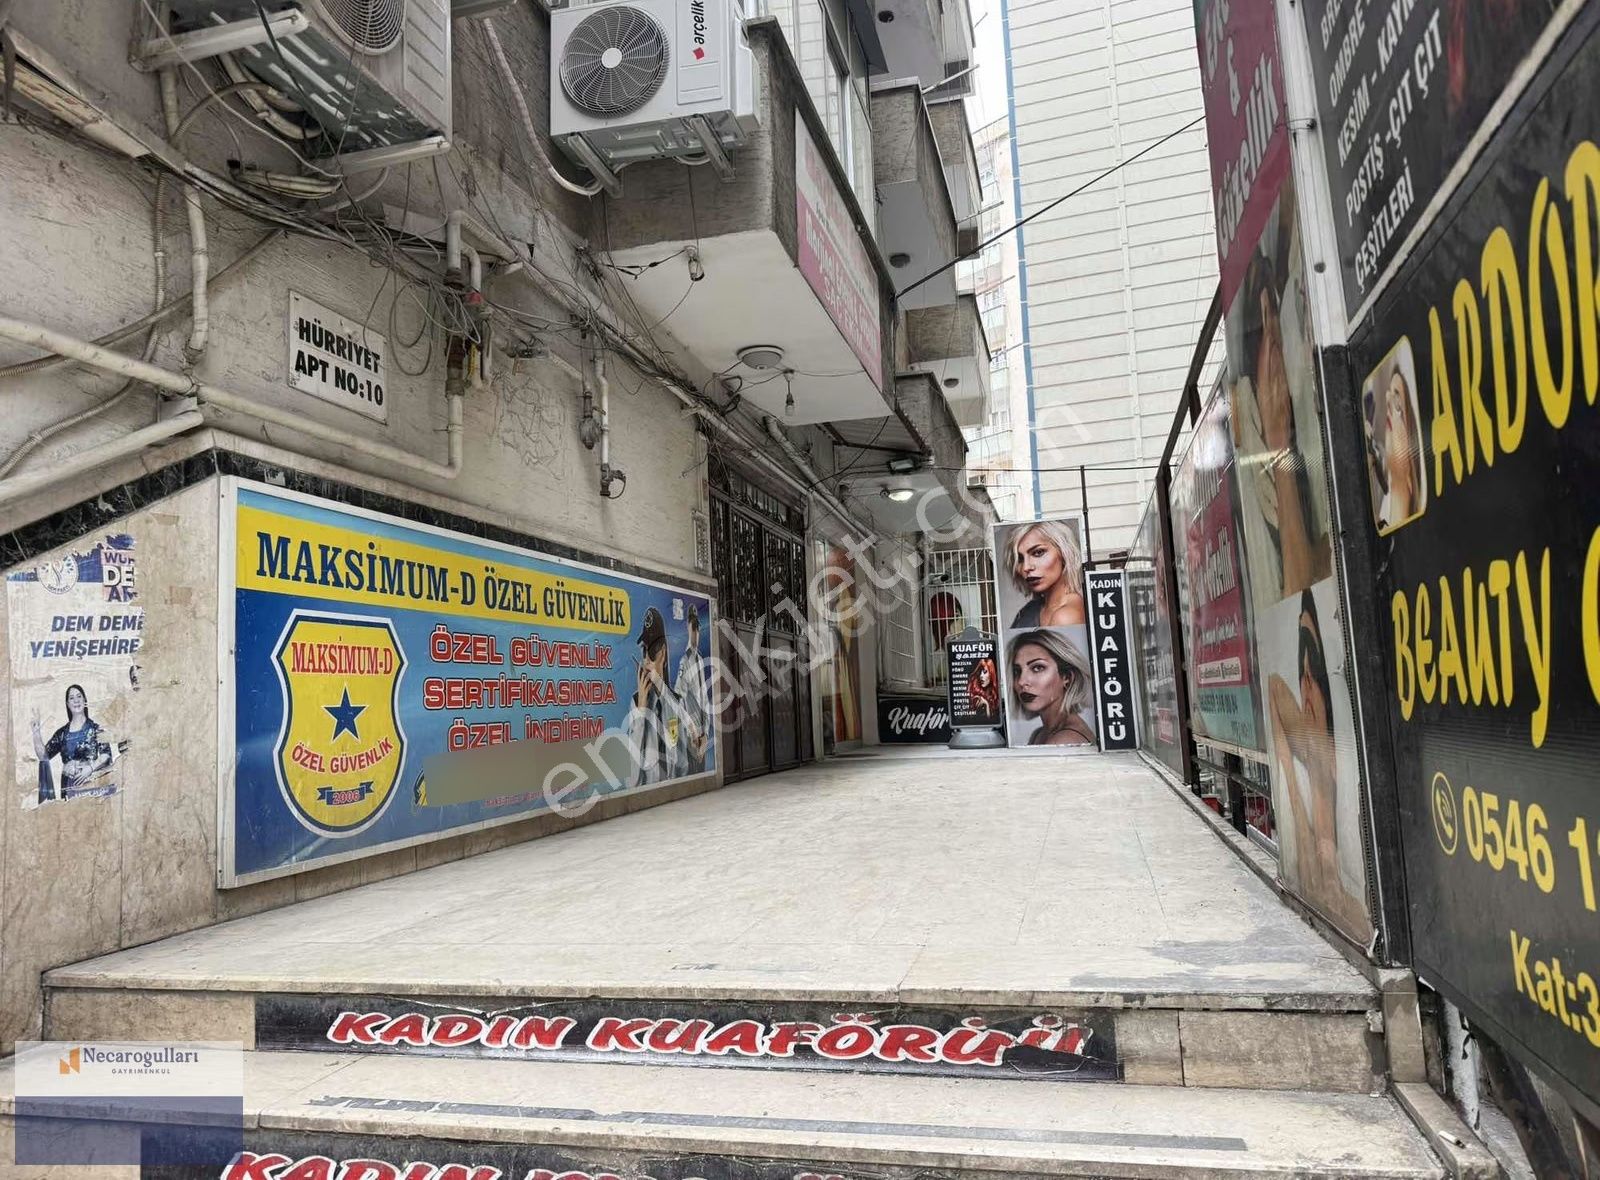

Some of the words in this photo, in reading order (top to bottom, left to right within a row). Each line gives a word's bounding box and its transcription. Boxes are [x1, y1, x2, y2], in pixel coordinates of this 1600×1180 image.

[691, 0, 708, 45] arçelik
[1320, 0, 1341, 52] BRE
[1227, 36, 1242, 118] &
[1329, 0, 1366, 107] OMBRE
[1337, 73, 1371, 168] KESİM
[1345, 132, 1385, 228] POSTİŞ
[1414, 8, 1443, 99] ÇIT
[1217, 52, 1279, 260] Güzellik
[1354, 157, 1415, 294] ÇEŞİTLERİ
[298, 316, 381, 374] HÜRRİYET
[294, 350, 330, 383] APT
[334, 366, 385, 406] NO:10
[256, 530, 477, 608] MAKSİMUM-D
[483, 565, 539, 616] ÖZEL
[542, 581, 626, 628] GÜVENLİK
[1090, 579, 1122, 590] KADIN
[51, 615, 94, 632] DEM
[429, 623, 504, 665] ÖZEL
[509, 631, 612, 670] GÜVENLİK
[951, 641, 993, 653] KUAFÖR
[290, 635, 394, 675] MAKSİMUM-D
[1097, 591, 1127, 742] KUAFÖRÜ
[423, 671, 618, 711] SERTİFİKASINDA
[290, 741, 326, 774] ÖZEL
[329, 736, 394, 775] GÜVENLİK
[447, 716, 519, 752] ÖZEL
[332, 790, 361, 804] 2006
[1462, 784, 1556, 894] 0546
[1567, 816, 1600, 913] 1
[326, 1010, 578, 1052] KADIN
